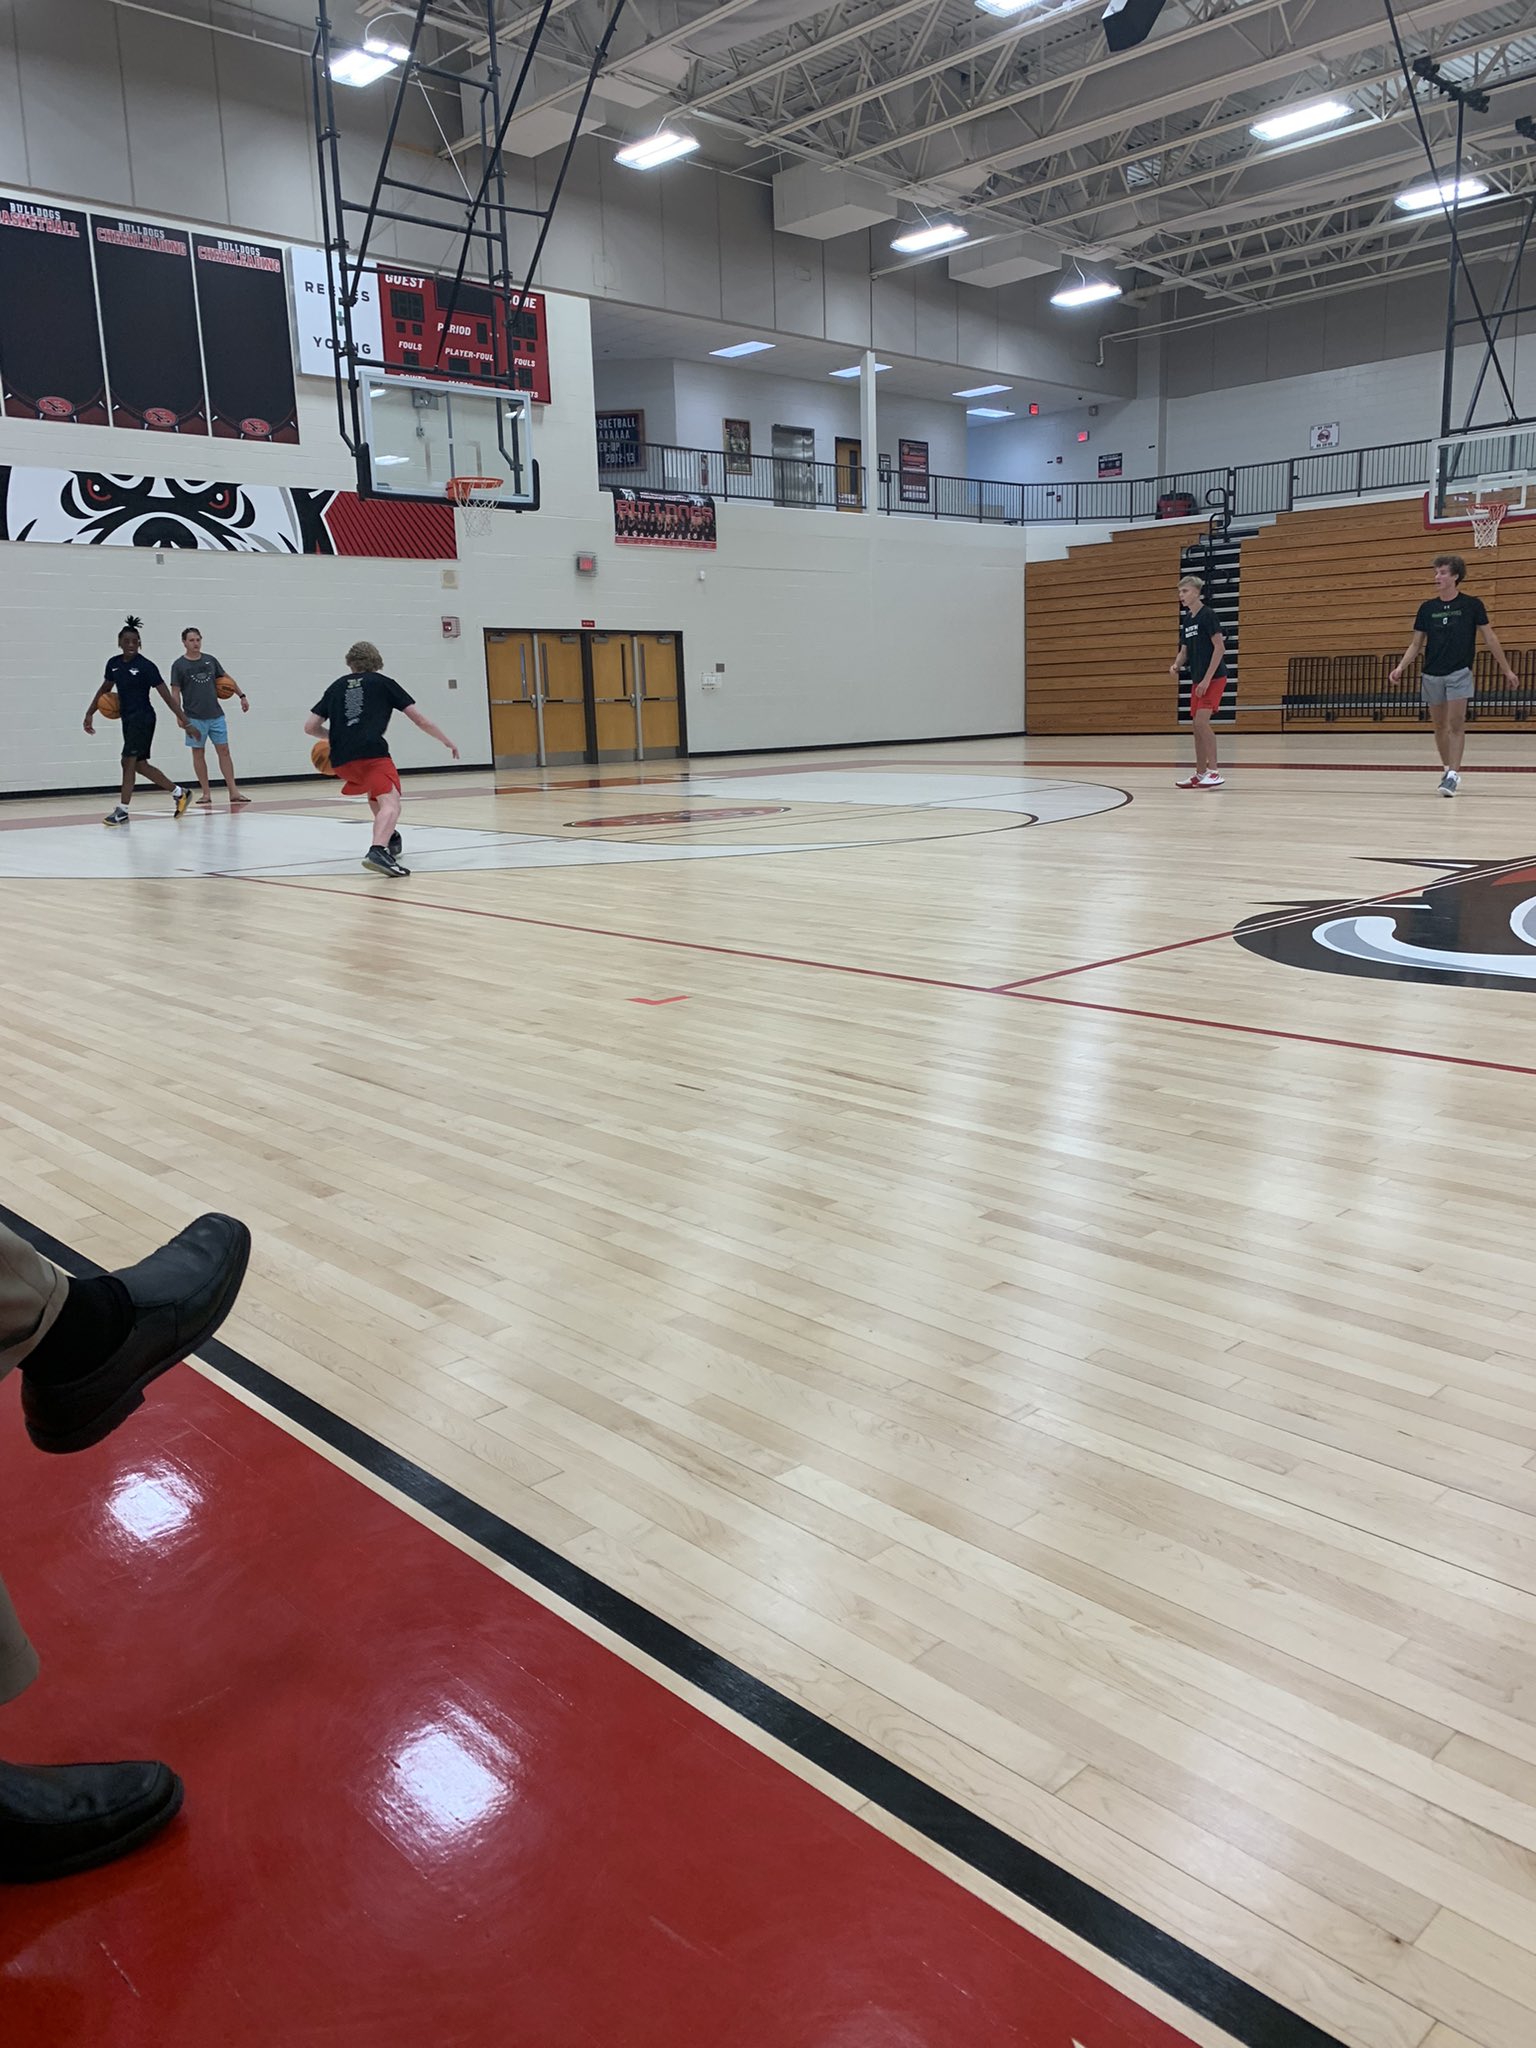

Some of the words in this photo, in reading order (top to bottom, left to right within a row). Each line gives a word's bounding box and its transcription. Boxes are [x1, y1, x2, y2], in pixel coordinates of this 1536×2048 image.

[9, 202, 61, 220] BULLDOGS
[0, 209, 80, 238] ASKETBALL
[118, 222, 165, 239] BULLDOGS
[96, 227, 187, 257] CHEERLEADING
[217, 241, 261, 257] BULLDOGS
[198, 245, 281, 273] CHEERLEADING
[385, 274, 426, 289] GUEST
[509, 294, 537, 310] OME
[437, 322, 472, 336] PRIOD
[398, 341, 423, 351] FOULS
[445, 347, 494, 361] PLAYER-FOUL
[514, 357, 536, 368] FOULS
[598, 417, 636, 429] SKETBALL
